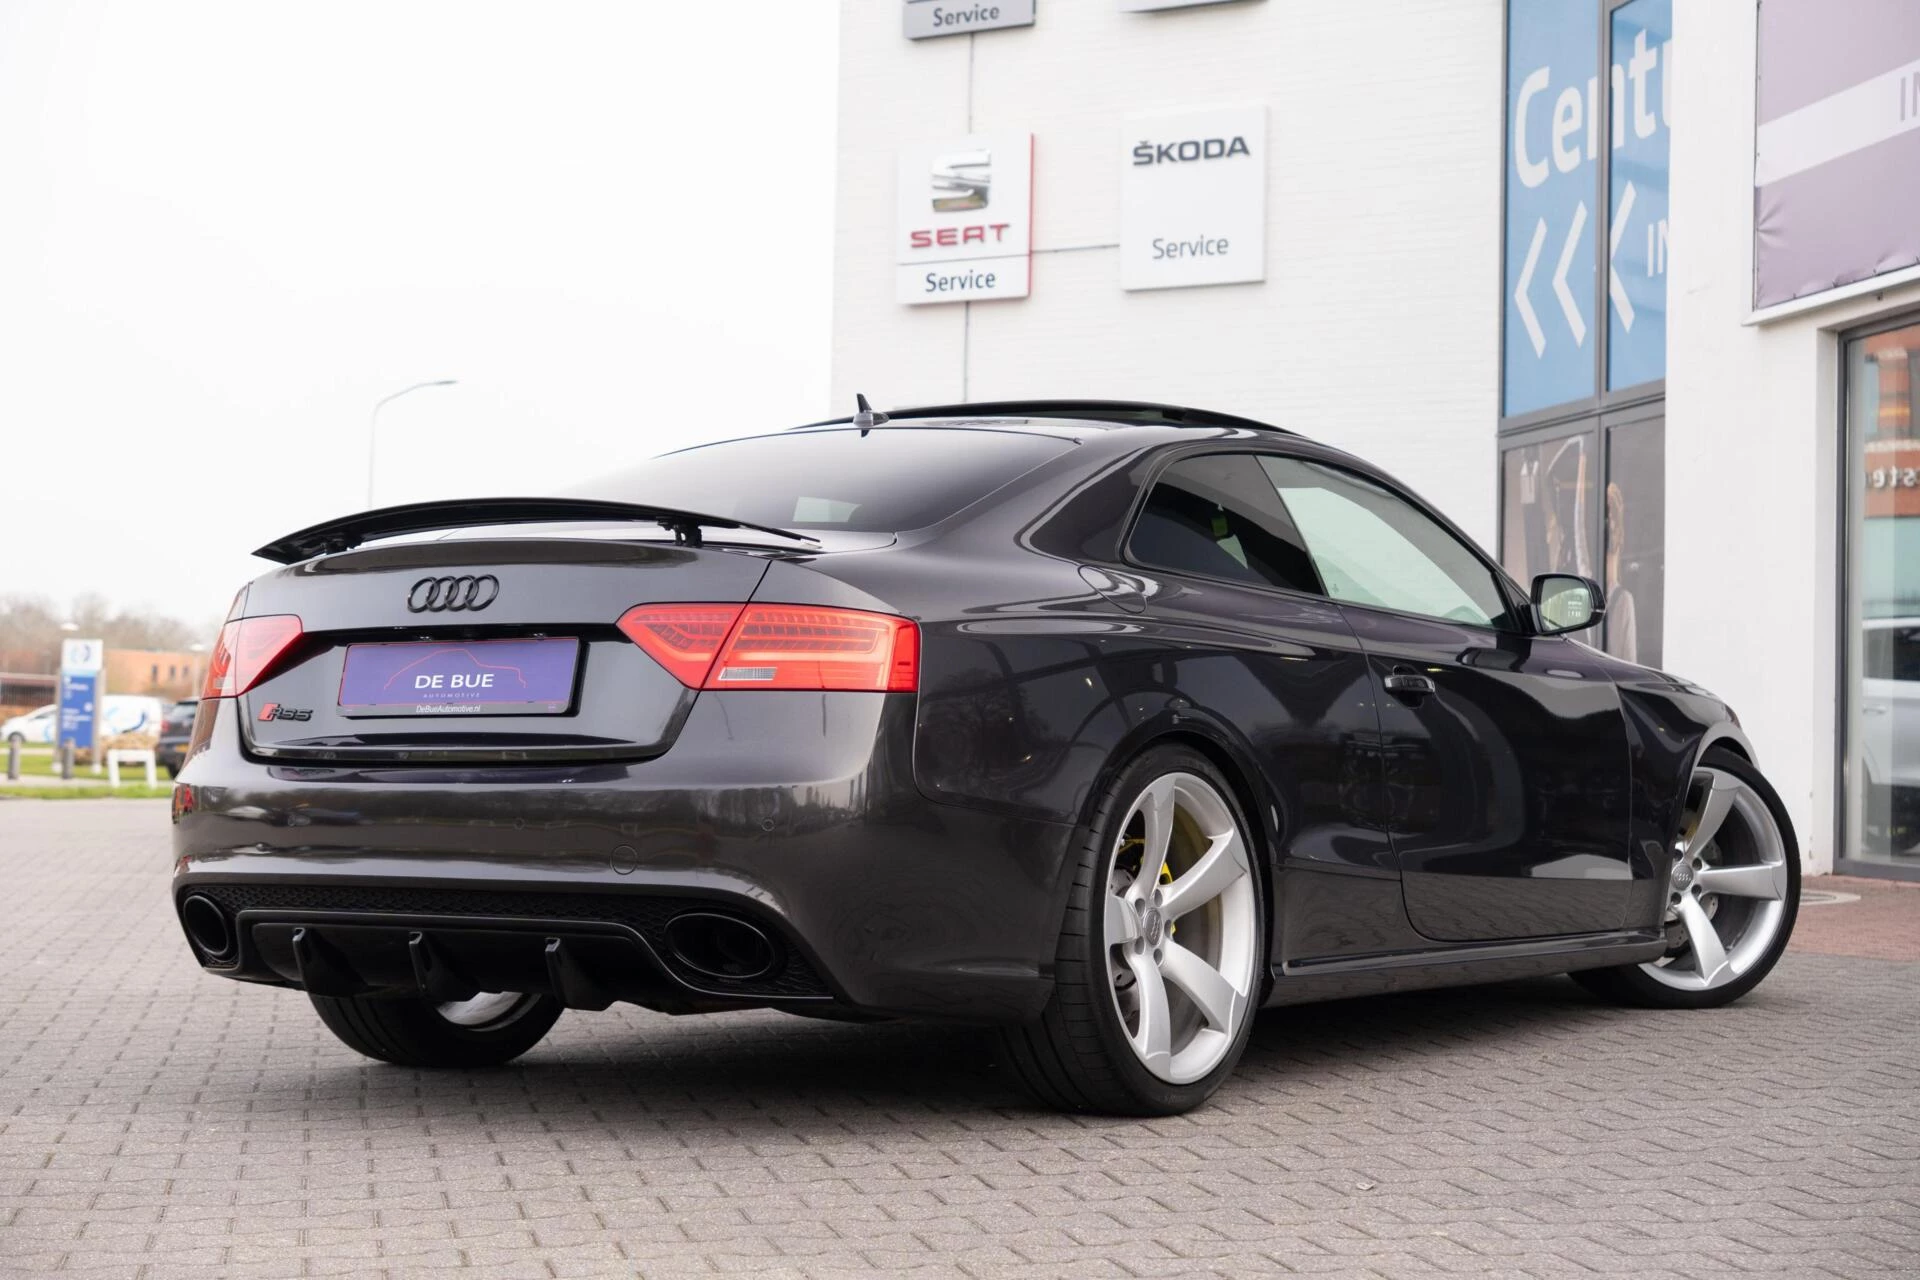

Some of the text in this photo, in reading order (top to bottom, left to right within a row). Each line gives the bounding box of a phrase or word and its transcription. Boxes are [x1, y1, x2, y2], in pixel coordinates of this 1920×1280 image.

[932, 4, 1000, 27] Service
[1132, 136, 1250, 166] ŠKODA
[910, 223, 1011, 248] SEAT
[1152, 234, 1229, 260] Service
[925, 269, 996, 293] Service
[414, 673, 495, 689] DE BUE
[415, 704, 481, 713] DeBueAutomotive.nl
